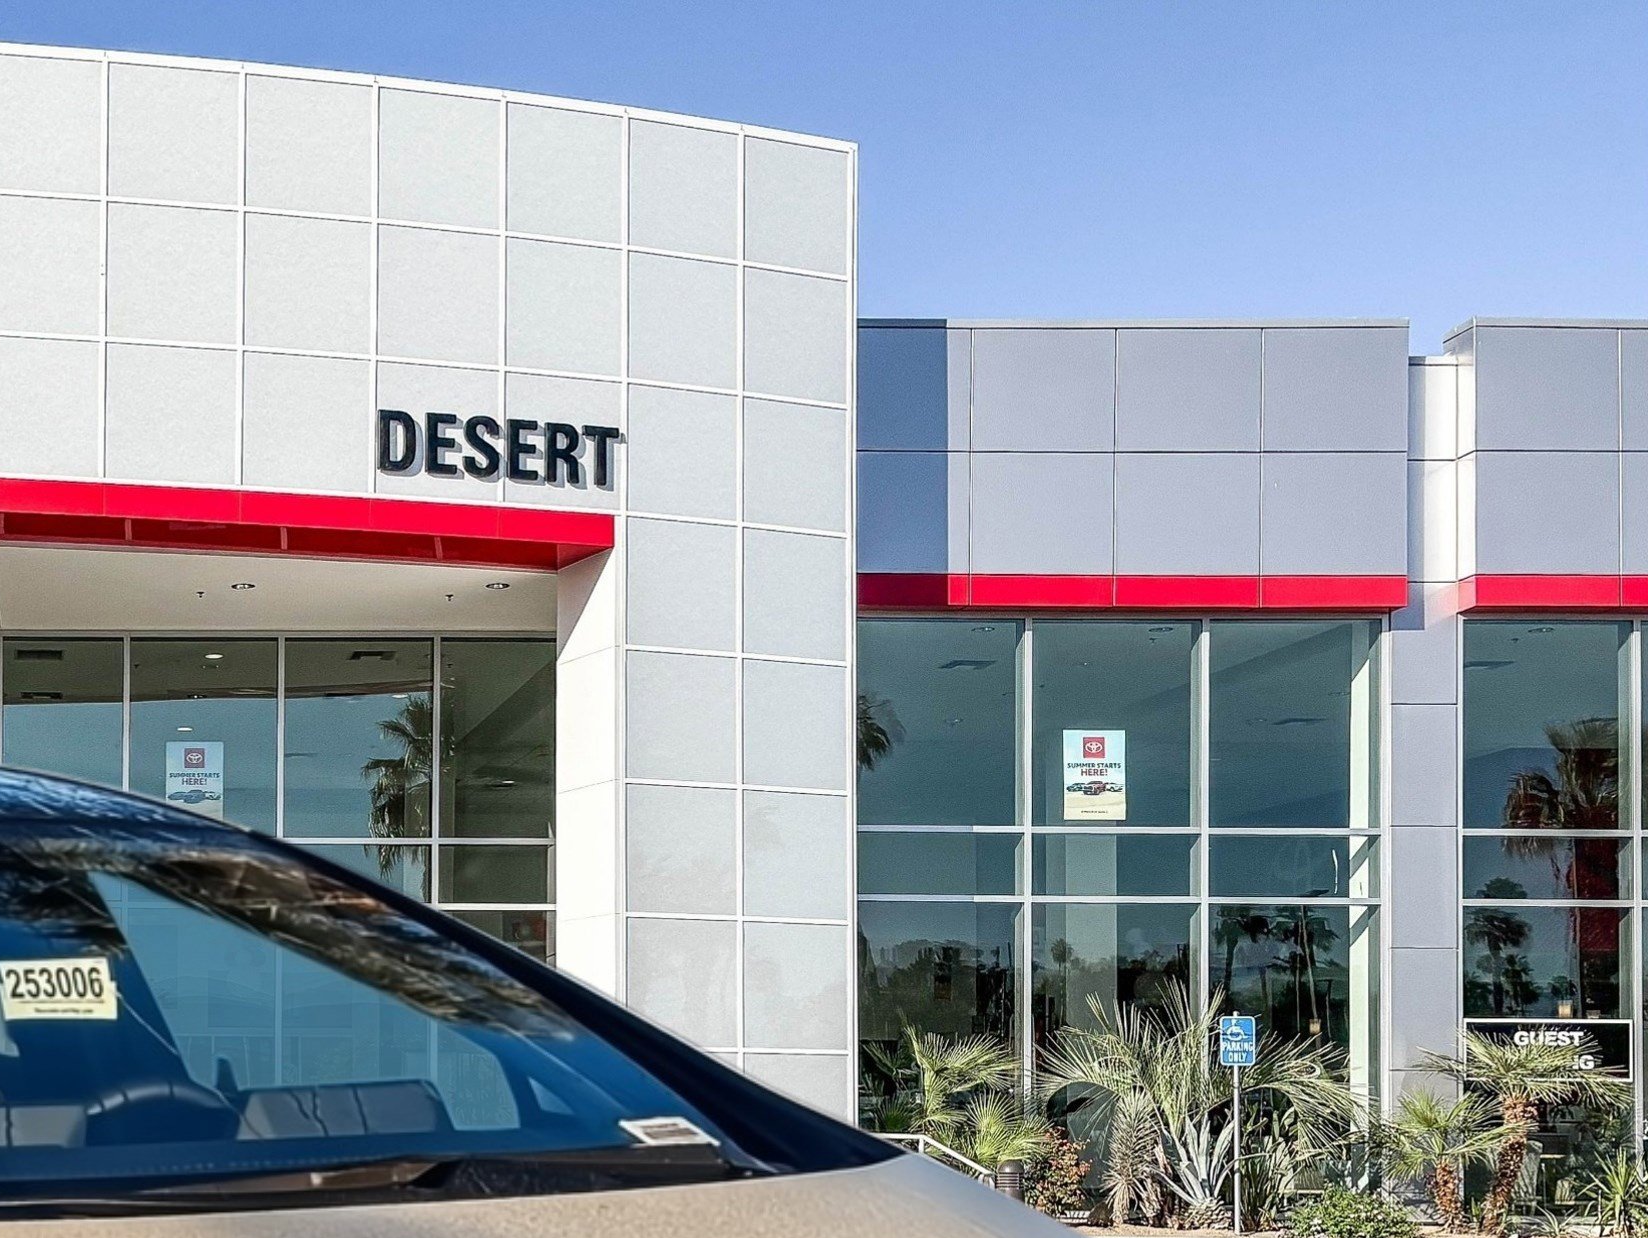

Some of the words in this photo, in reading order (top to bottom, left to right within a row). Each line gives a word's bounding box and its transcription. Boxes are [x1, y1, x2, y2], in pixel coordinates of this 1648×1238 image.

[376, 408, 621, 487] DESERT
[1081, 768, 1109, 777] HERE!
[181, 777, 207, 786] HERE!
[5, 966, 104, 999] 253006
[1513, 1030, 1584, 1047] GUEST
[1222, 1041, 1254, 1052] PARKING
[1228, 1051, 1248, 1063] ONLY
